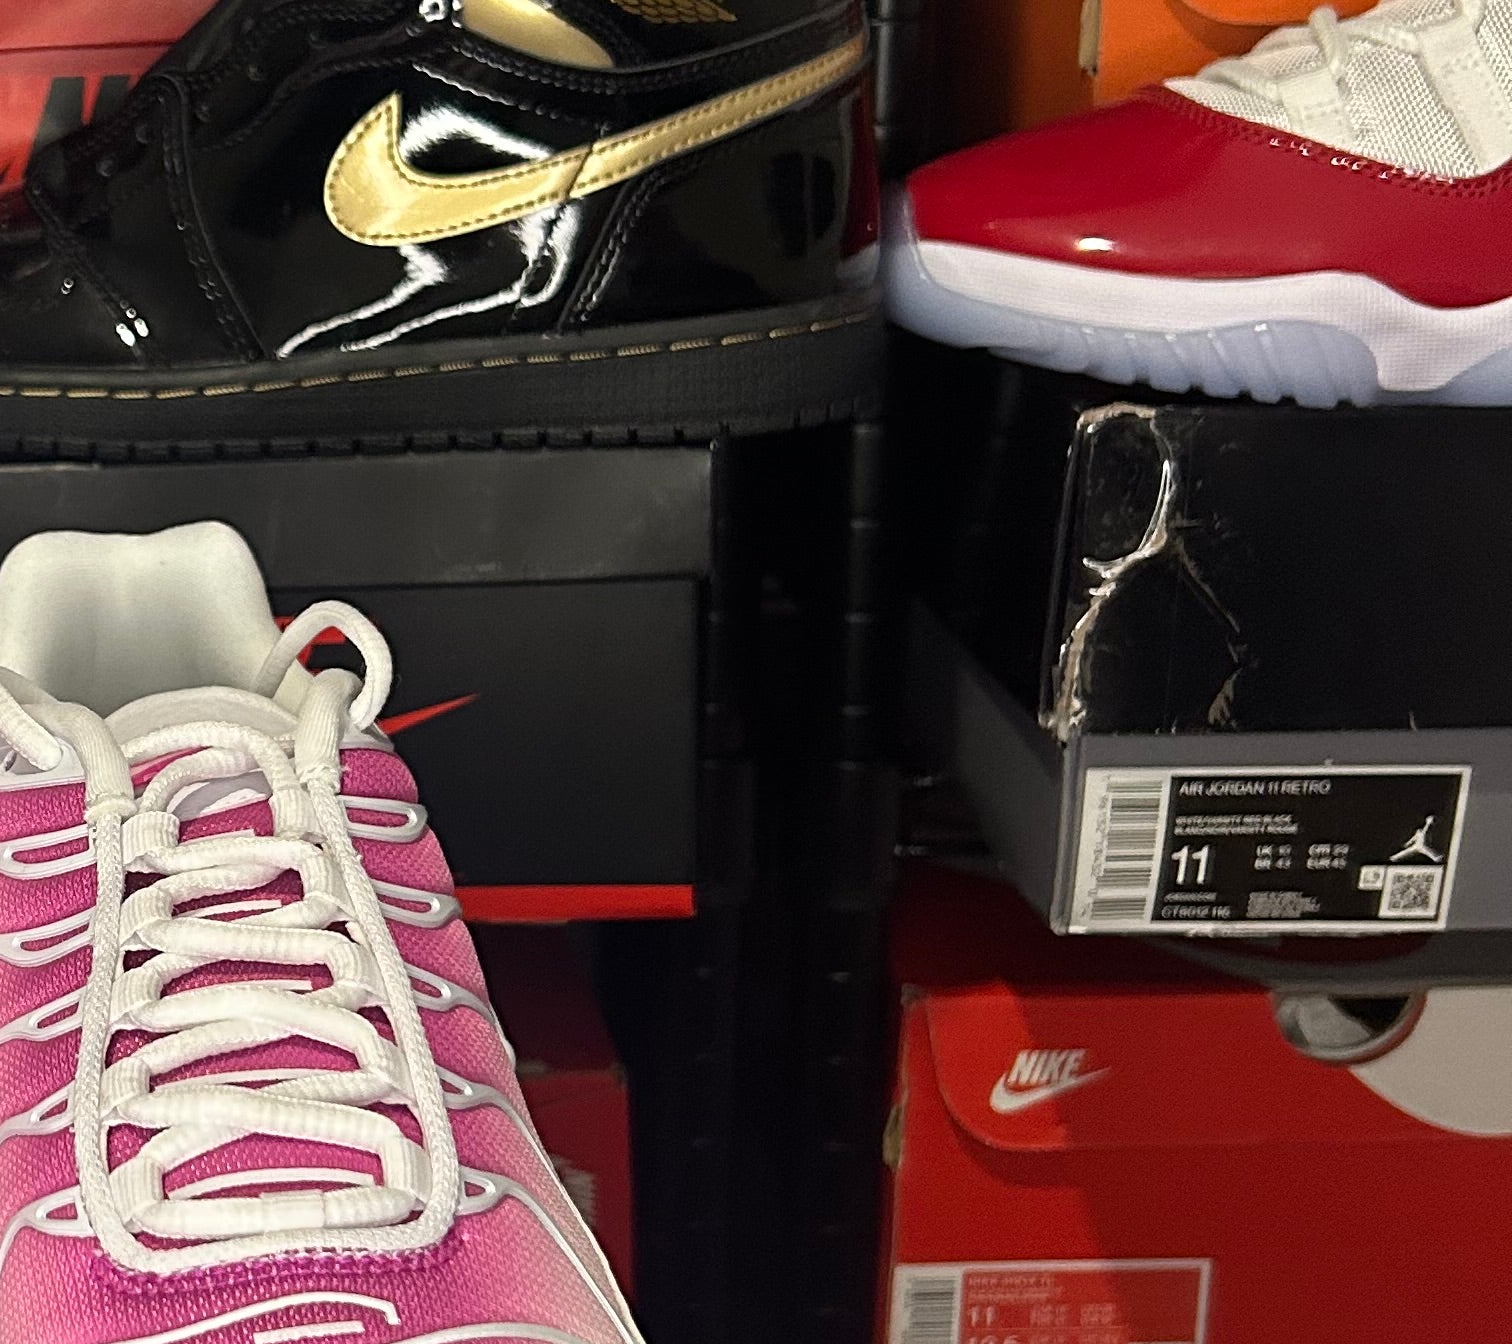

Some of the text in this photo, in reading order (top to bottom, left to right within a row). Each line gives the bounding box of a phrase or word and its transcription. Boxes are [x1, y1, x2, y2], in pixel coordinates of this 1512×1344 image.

[1205, 780, 1265, 797] JORDAN
[1171, 844, 1211, 886] 11
[1007, 1048, 1087, 1085] NIKE
[968, 1306, 996, 1325] 11
